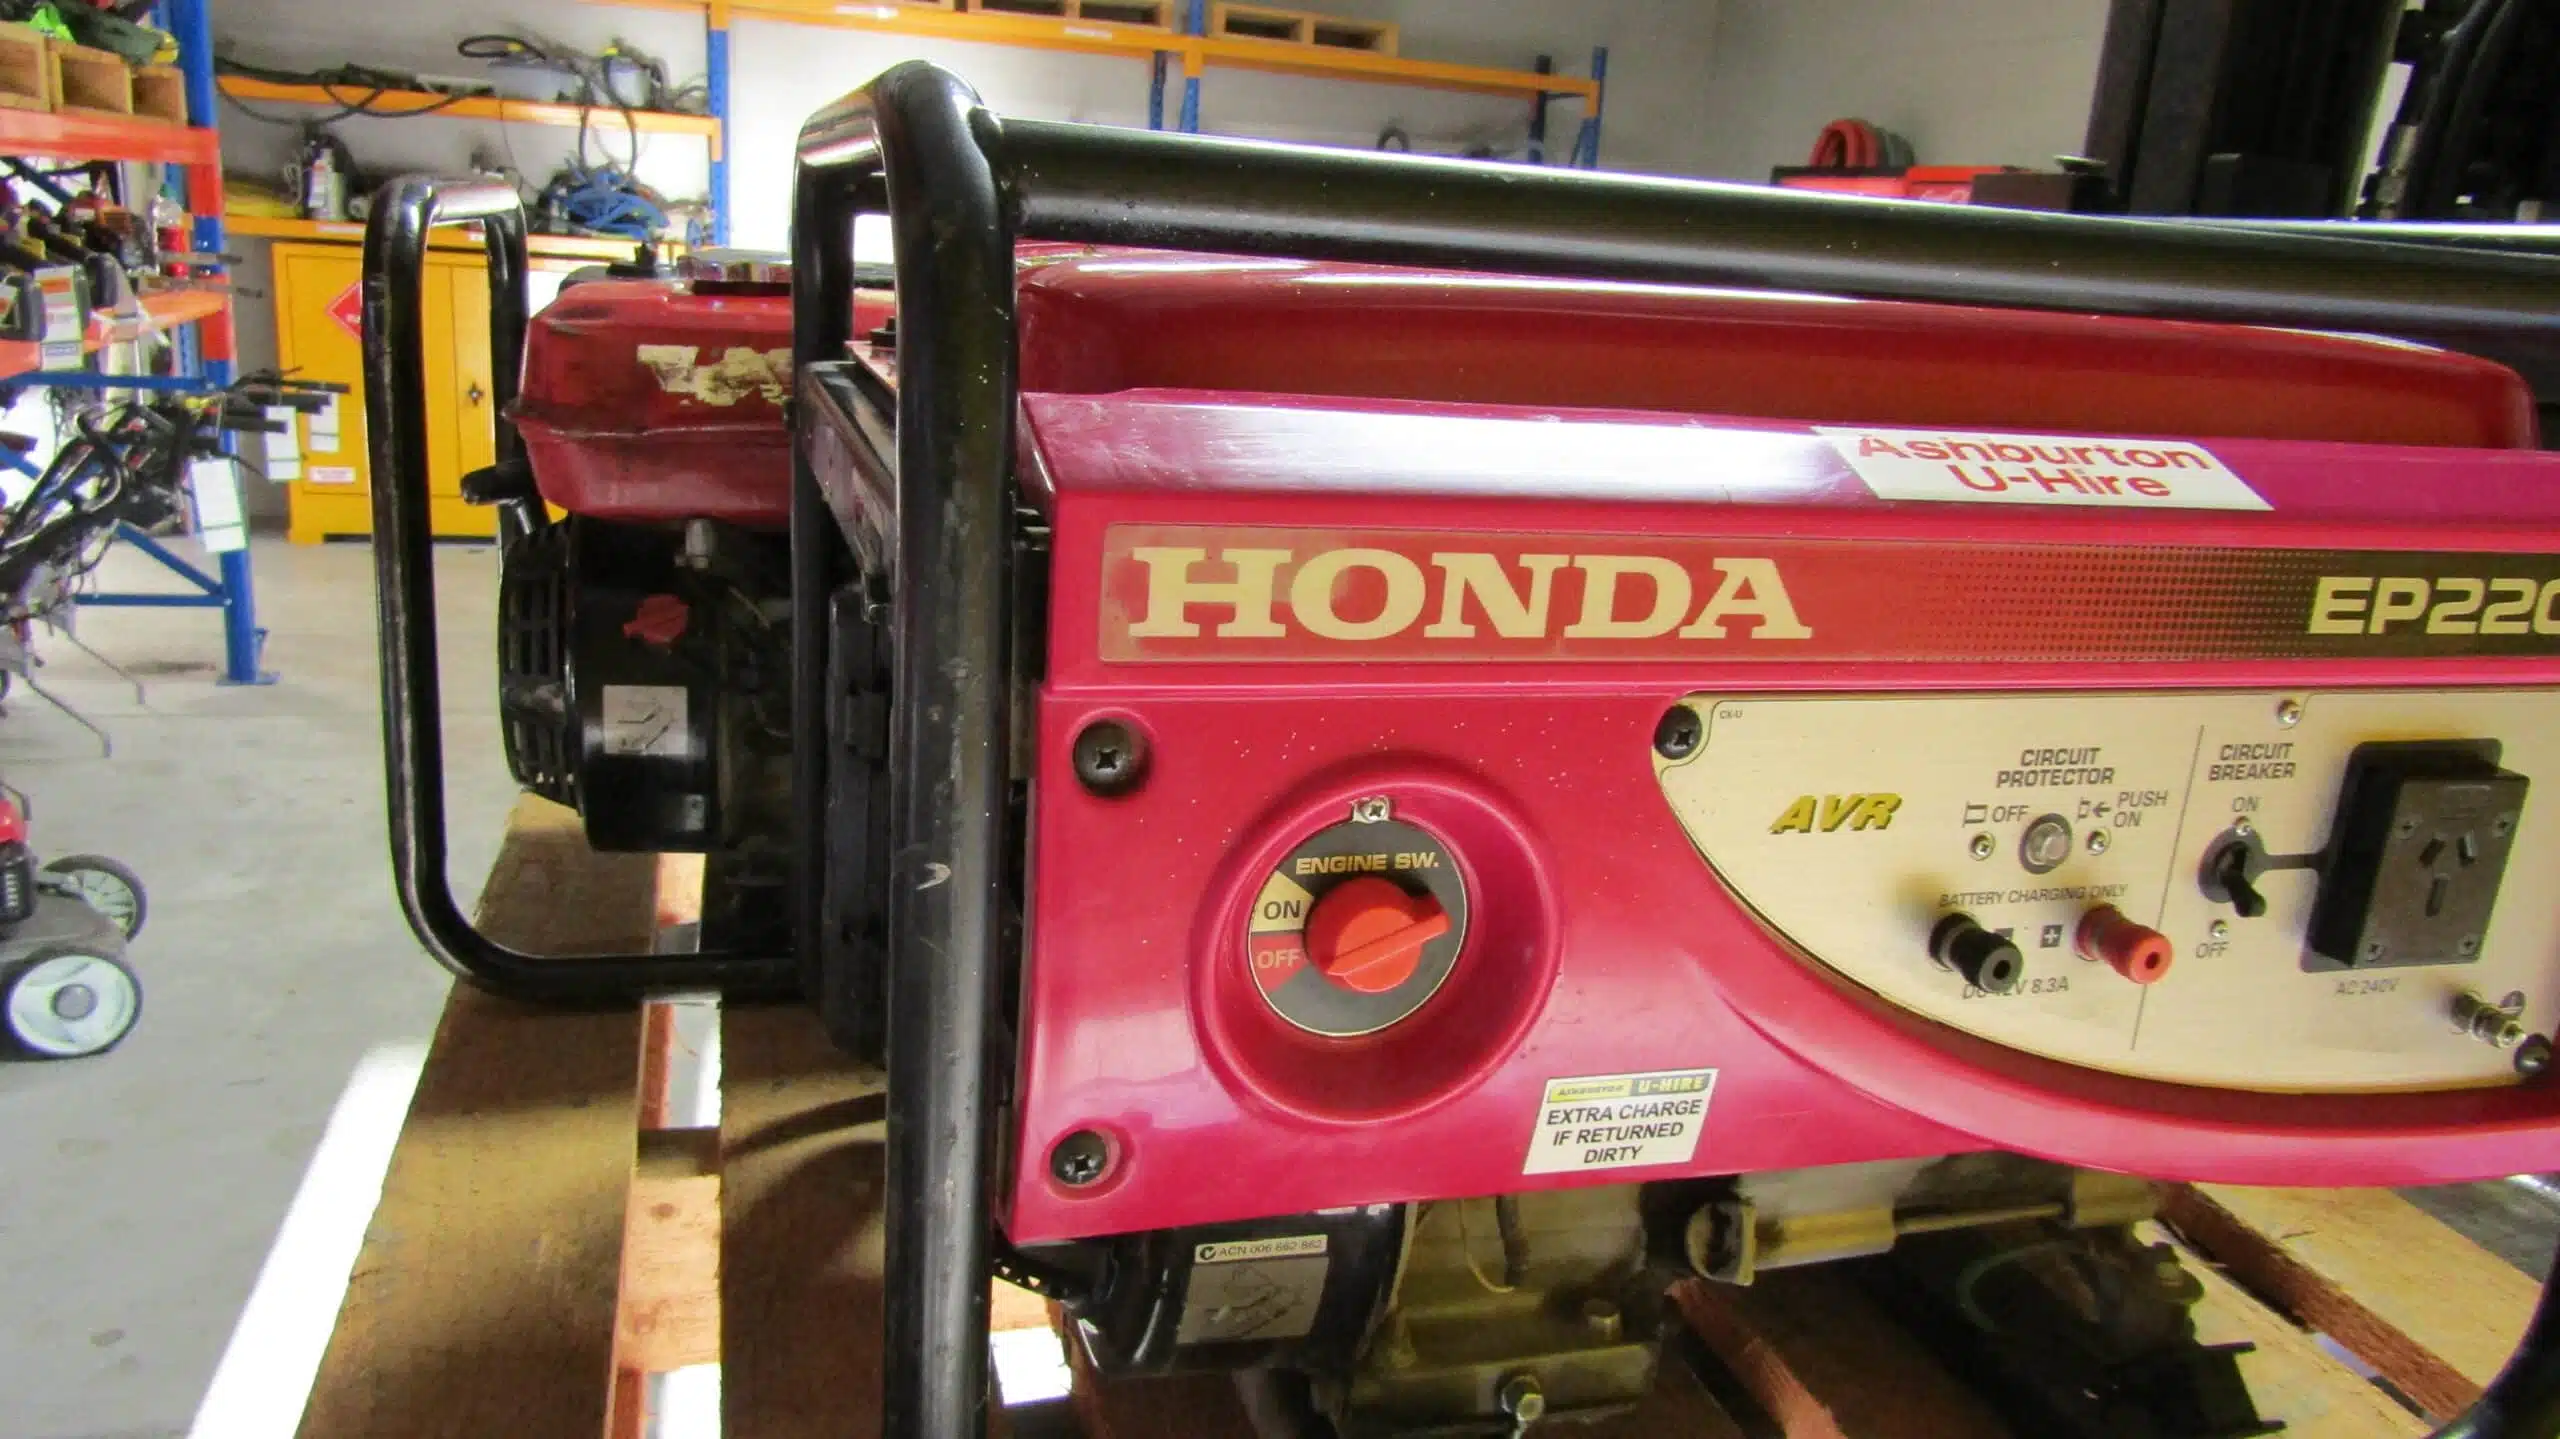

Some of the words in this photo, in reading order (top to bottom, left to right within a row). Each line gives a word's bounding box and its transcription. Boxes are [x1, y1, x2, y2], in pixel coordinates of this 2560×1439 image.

[1858, 434, 2213, 471] Ashburton
[1946, 464, 2172, 497] U-Hire
[1128, 546, 1814, 641] HONDA
[2020, 747, 2102, 768] CIRCUIT
[2219, 742, 2294, 761] CIRCUIT
[1996, 767, 2116, 789] PROTECTOR
[2207, 761, 2297, 781] BREAKER
[2116, 789, 2169, 809] PUSH
[2231, 795, 2262, 813] ON
[1769, 792, 1904, 835] AVR
[1991, 804, 2029, 824] OFF
[2112, 810, 2142, 829] ON
[1295, 853, 1389, 876] ENGINE
[1393, 851, 1440, 871] SW.
[1939, 890, 2007, 909] BATTERY
[2007, 885, 2087, 905] CHARGING
[2089, 882, 2129, 899] ONLY
[1263, 899, 1302, 921] ON
[1255, 947, 1301, 970] OFF
[2194, 940, 2230, 960] OFF
[2031, 975, 2070, 995] 8.3A
[1547, 1106, 1613, 1126] EXTRA
[1619, 1099, 1703, 1120] CHARGE
[1552, 1129, 1573, 1147] IF
[1576, 1121, 1685, 1145] RETURNED
[1583, 1145, 1644, 1164] DIRTY
[1219, 1245, 1248, 1258] ACN
